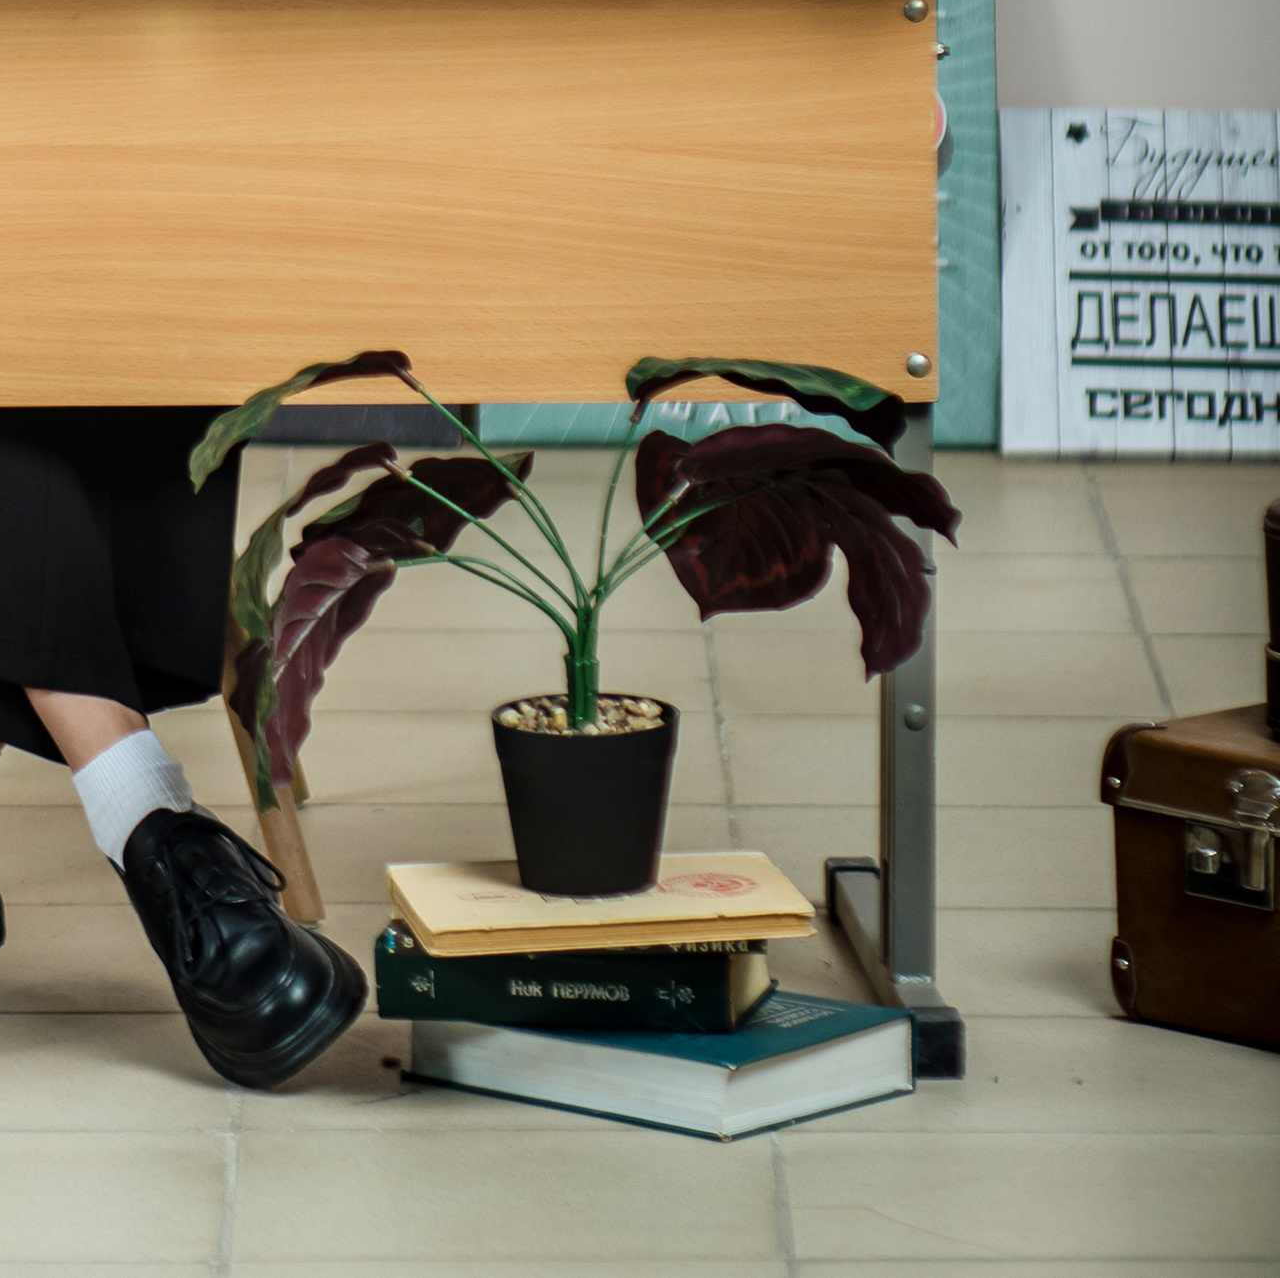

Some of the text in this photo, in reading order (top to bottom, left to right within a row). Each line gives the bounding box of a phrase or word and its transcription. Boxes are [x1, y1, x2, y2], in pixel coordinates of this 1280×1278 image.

[1080, 241, 1112, 259] от
[1124, 241, 1200, 266] того,
[1212, 243, 1264, 264] что
[552, 981, 631, 1002] ПЕРУМОВ
